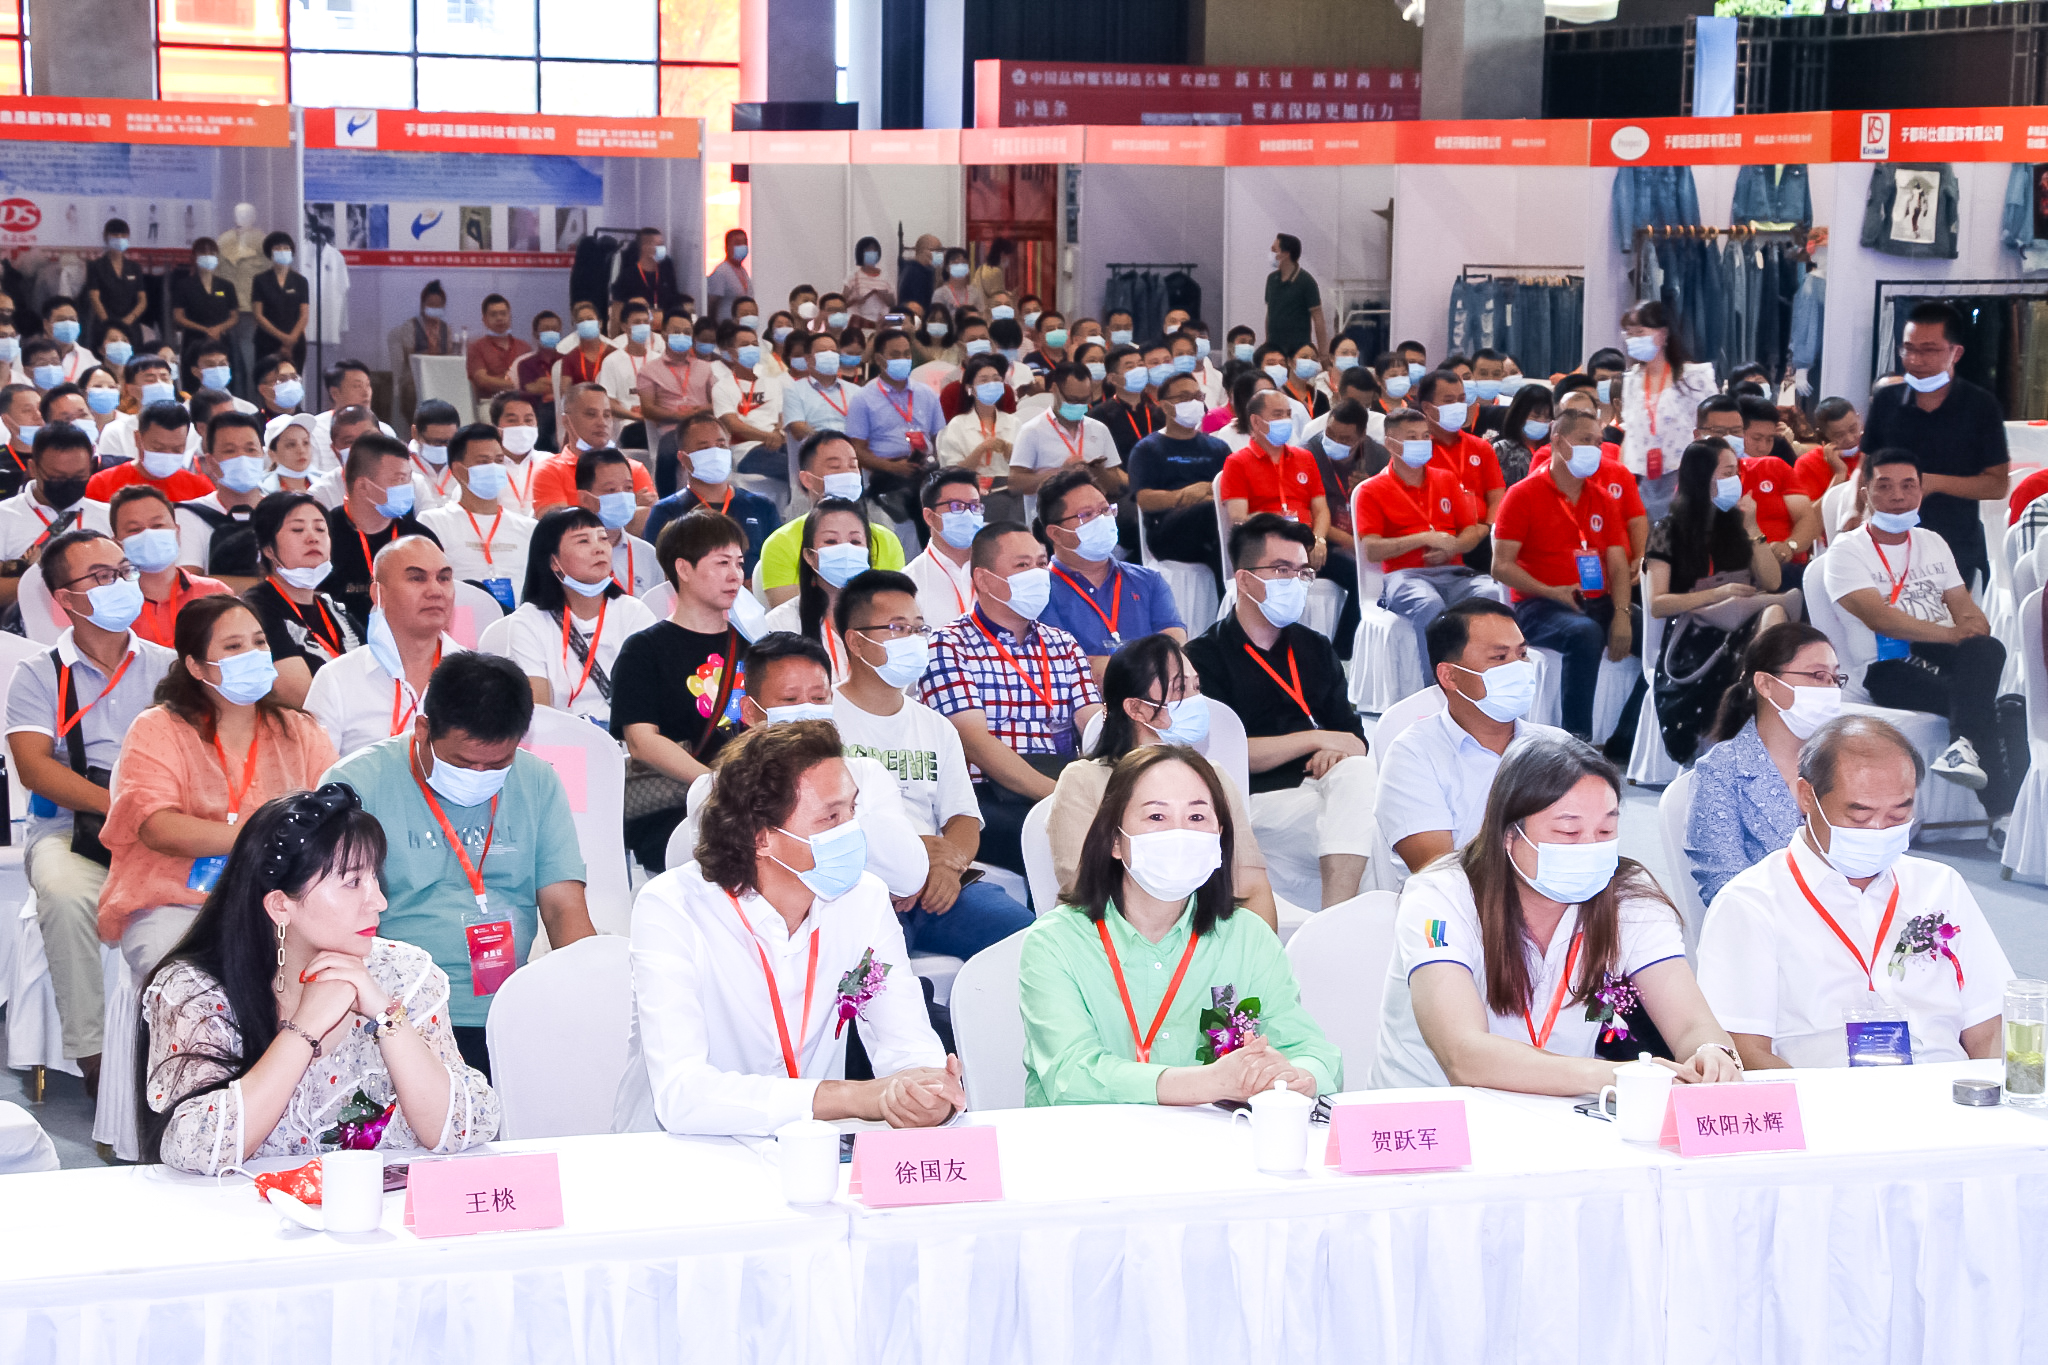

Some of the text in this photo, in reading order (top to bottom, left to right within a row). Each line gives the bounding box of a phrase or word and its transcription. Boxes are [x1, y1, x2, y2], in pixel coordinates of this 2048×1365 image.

[1252, 102, 1394, 120] 要素保障更加有力
[1696, 1111, 1785, 1137] 欧阳永辉
[1371, 1128, 1439, 1153] 贺跃军
[894, 1158, 968, 1185] 徐国友
[465, 1187, 517, 1214] 王棪
